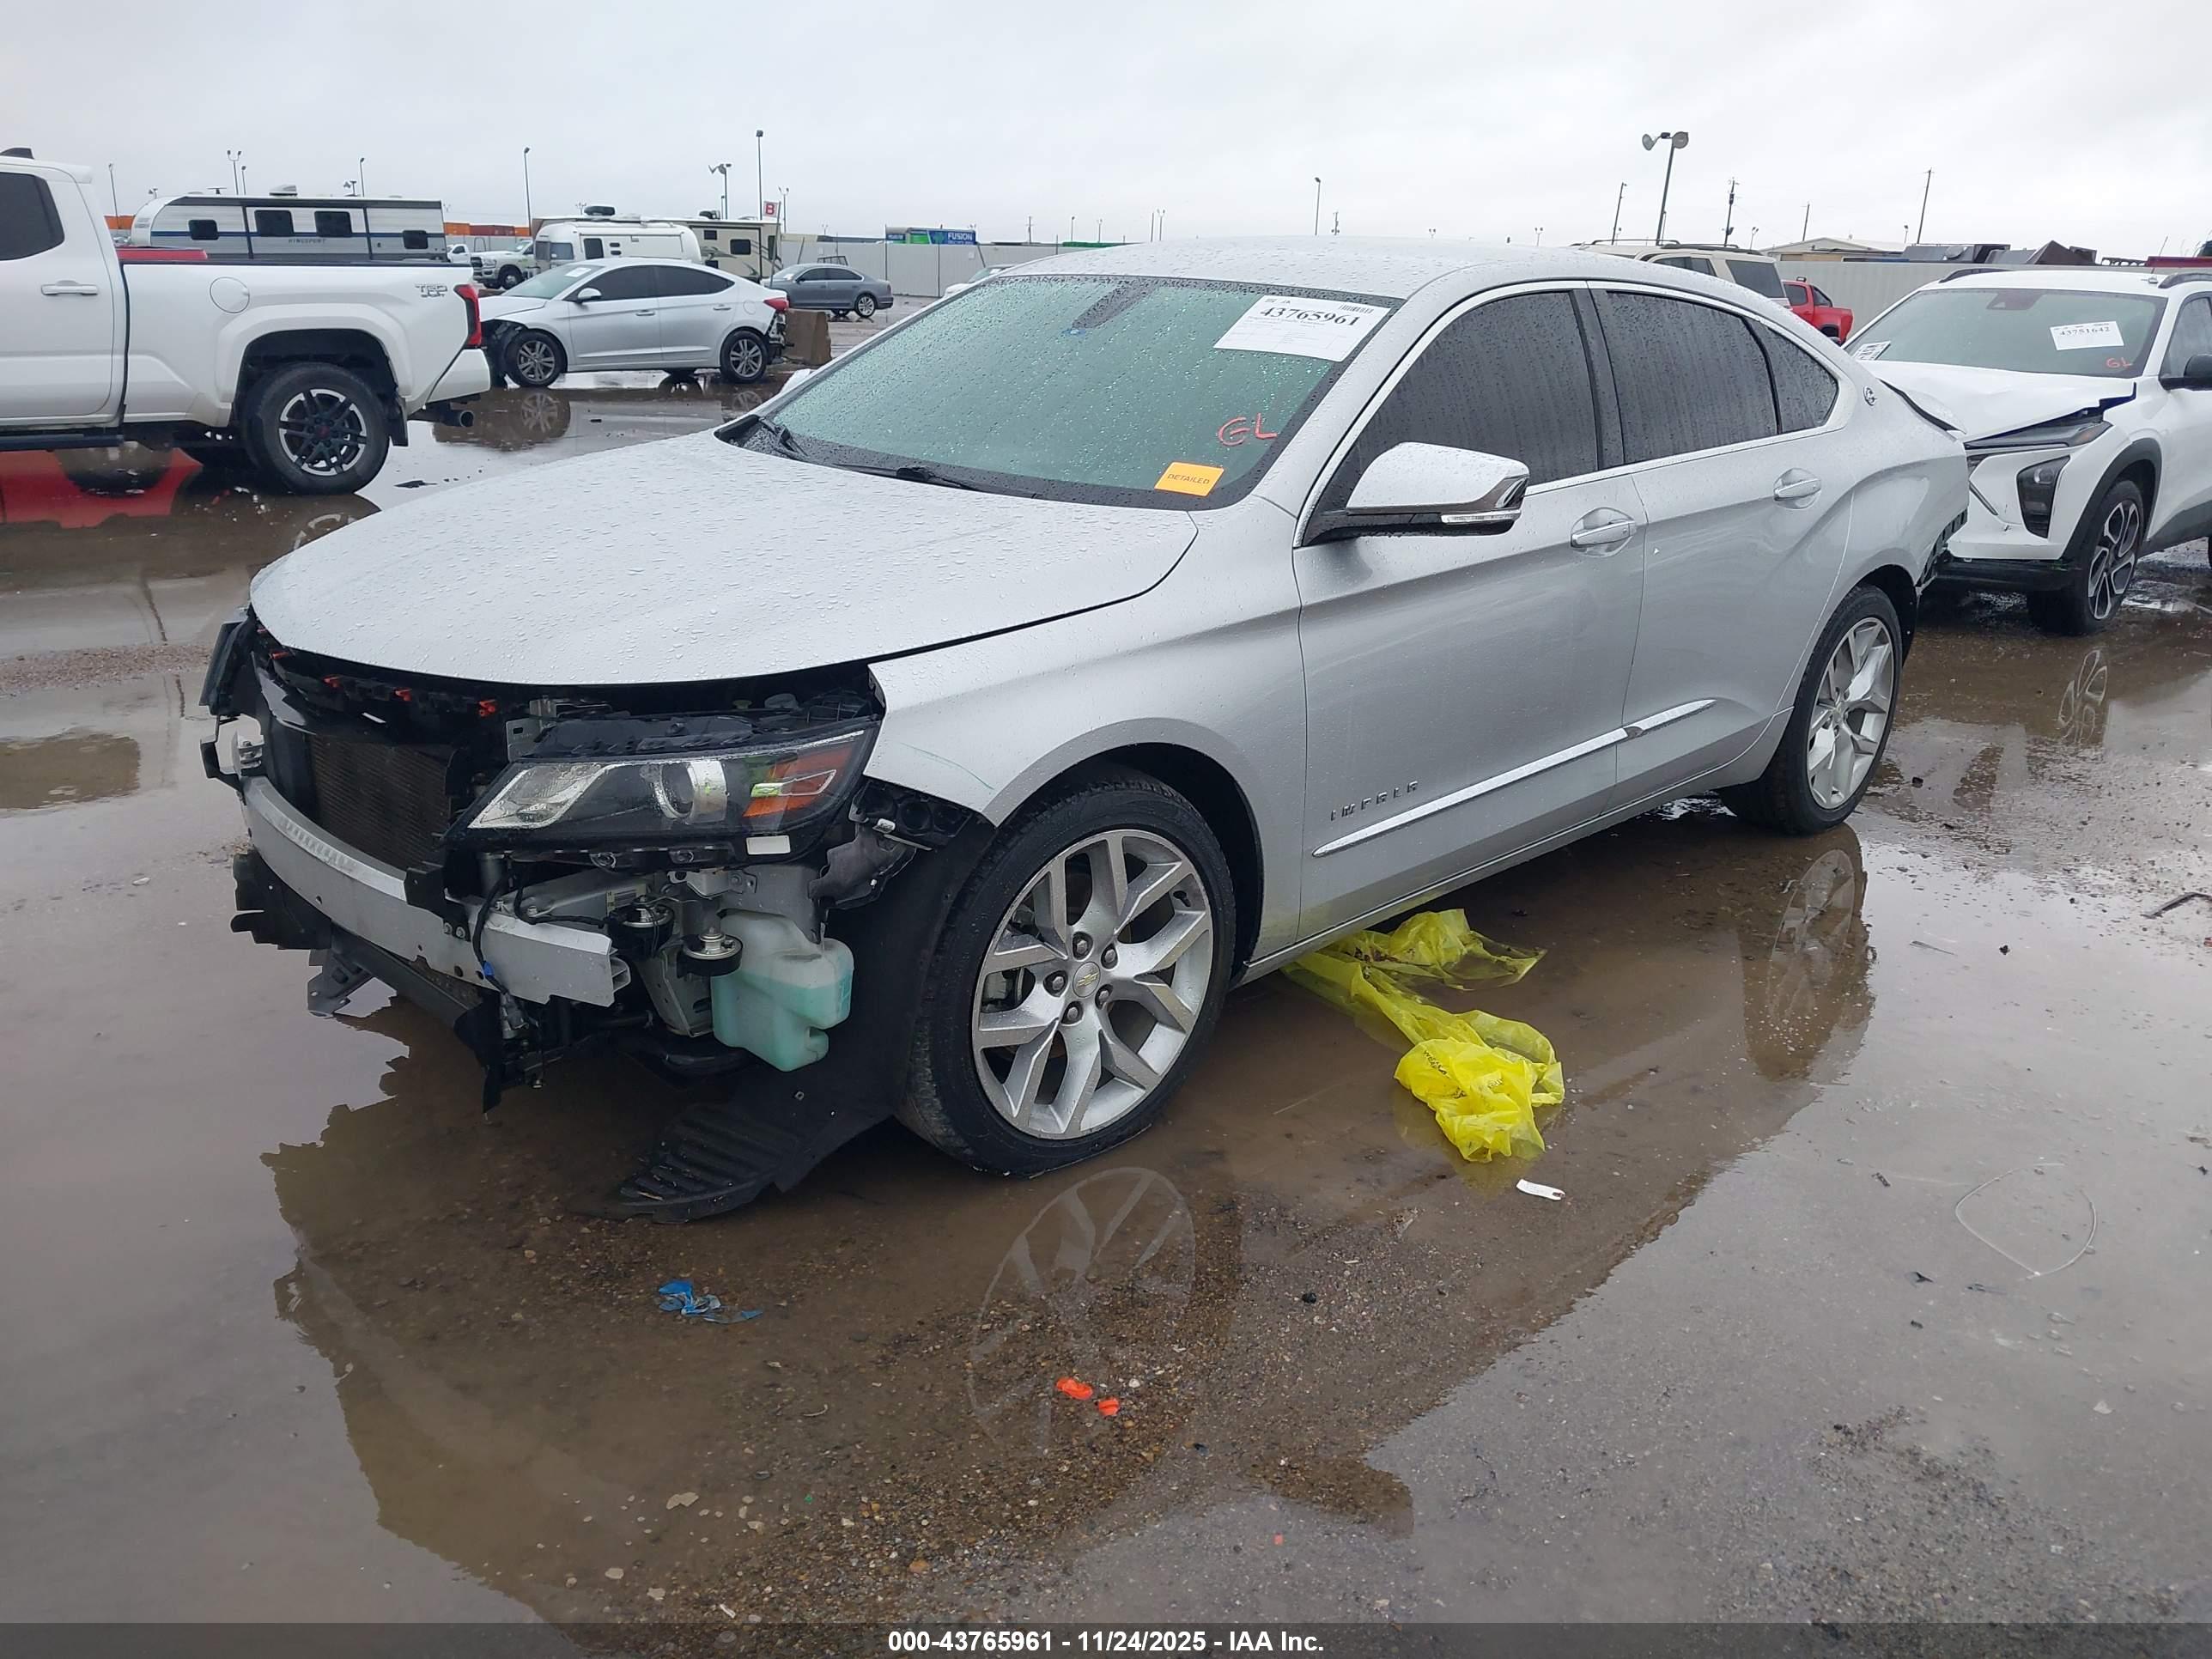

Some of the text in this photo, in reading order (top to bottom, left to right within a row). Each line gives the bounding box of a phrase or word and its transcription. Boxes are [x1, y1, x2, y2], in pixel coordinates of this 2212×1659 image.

[765, 203, 775, 215] B
[947, 232, 974, 241] FUSION
[1260, 307, 1361, 326] 43765961
[2059, 326, 2111, 336] 43751642
[1167, 473, 1210, 484] DETAILED
